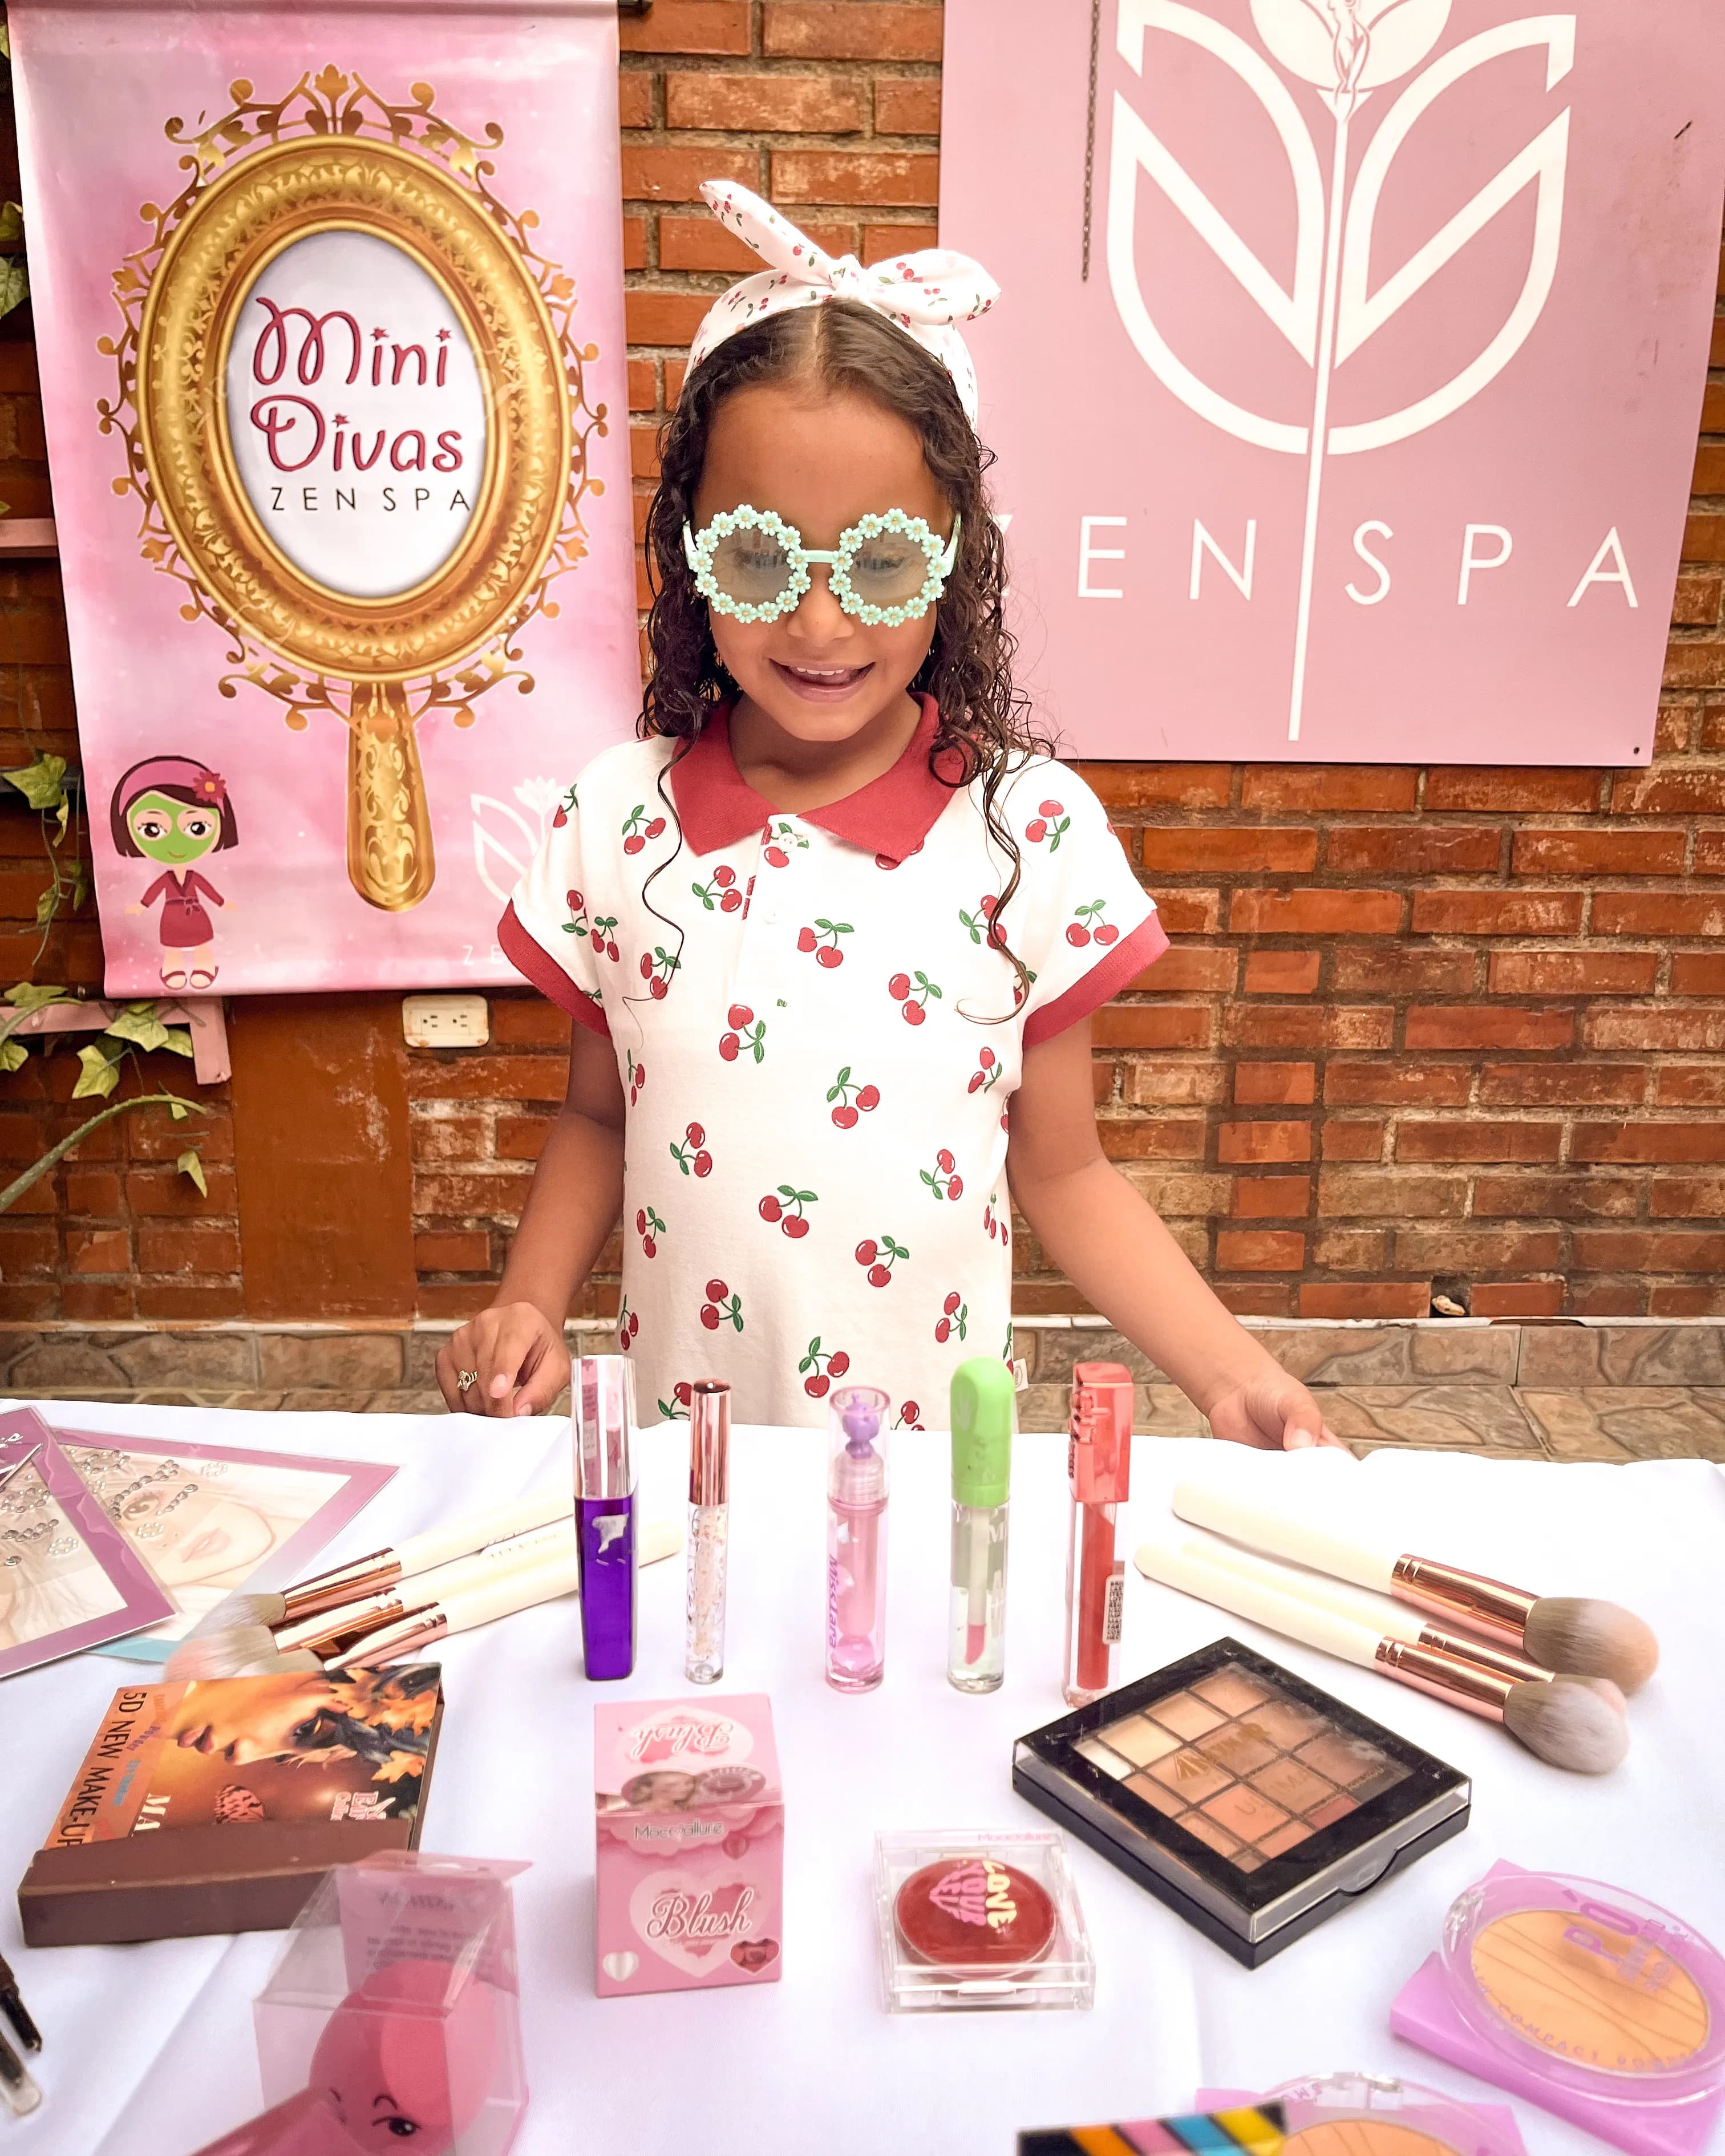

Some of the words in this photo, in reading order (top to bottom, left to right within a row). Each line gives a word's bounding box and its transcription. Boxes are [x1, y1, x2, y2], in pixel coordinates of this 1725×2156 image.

[253, 297, 452, 387] Mini
[250, 395, 463, 472] Divas
[990, 514, 1257, 601] EN
[119, 1692, 147, 1713] 5D
[97, 1720, 136, 1759] NEW
[131, 1793, 171, 1837] MA
[646, 1886, 756, 1940] Blush
[982, 1860, 1017, 1929] LOVE
